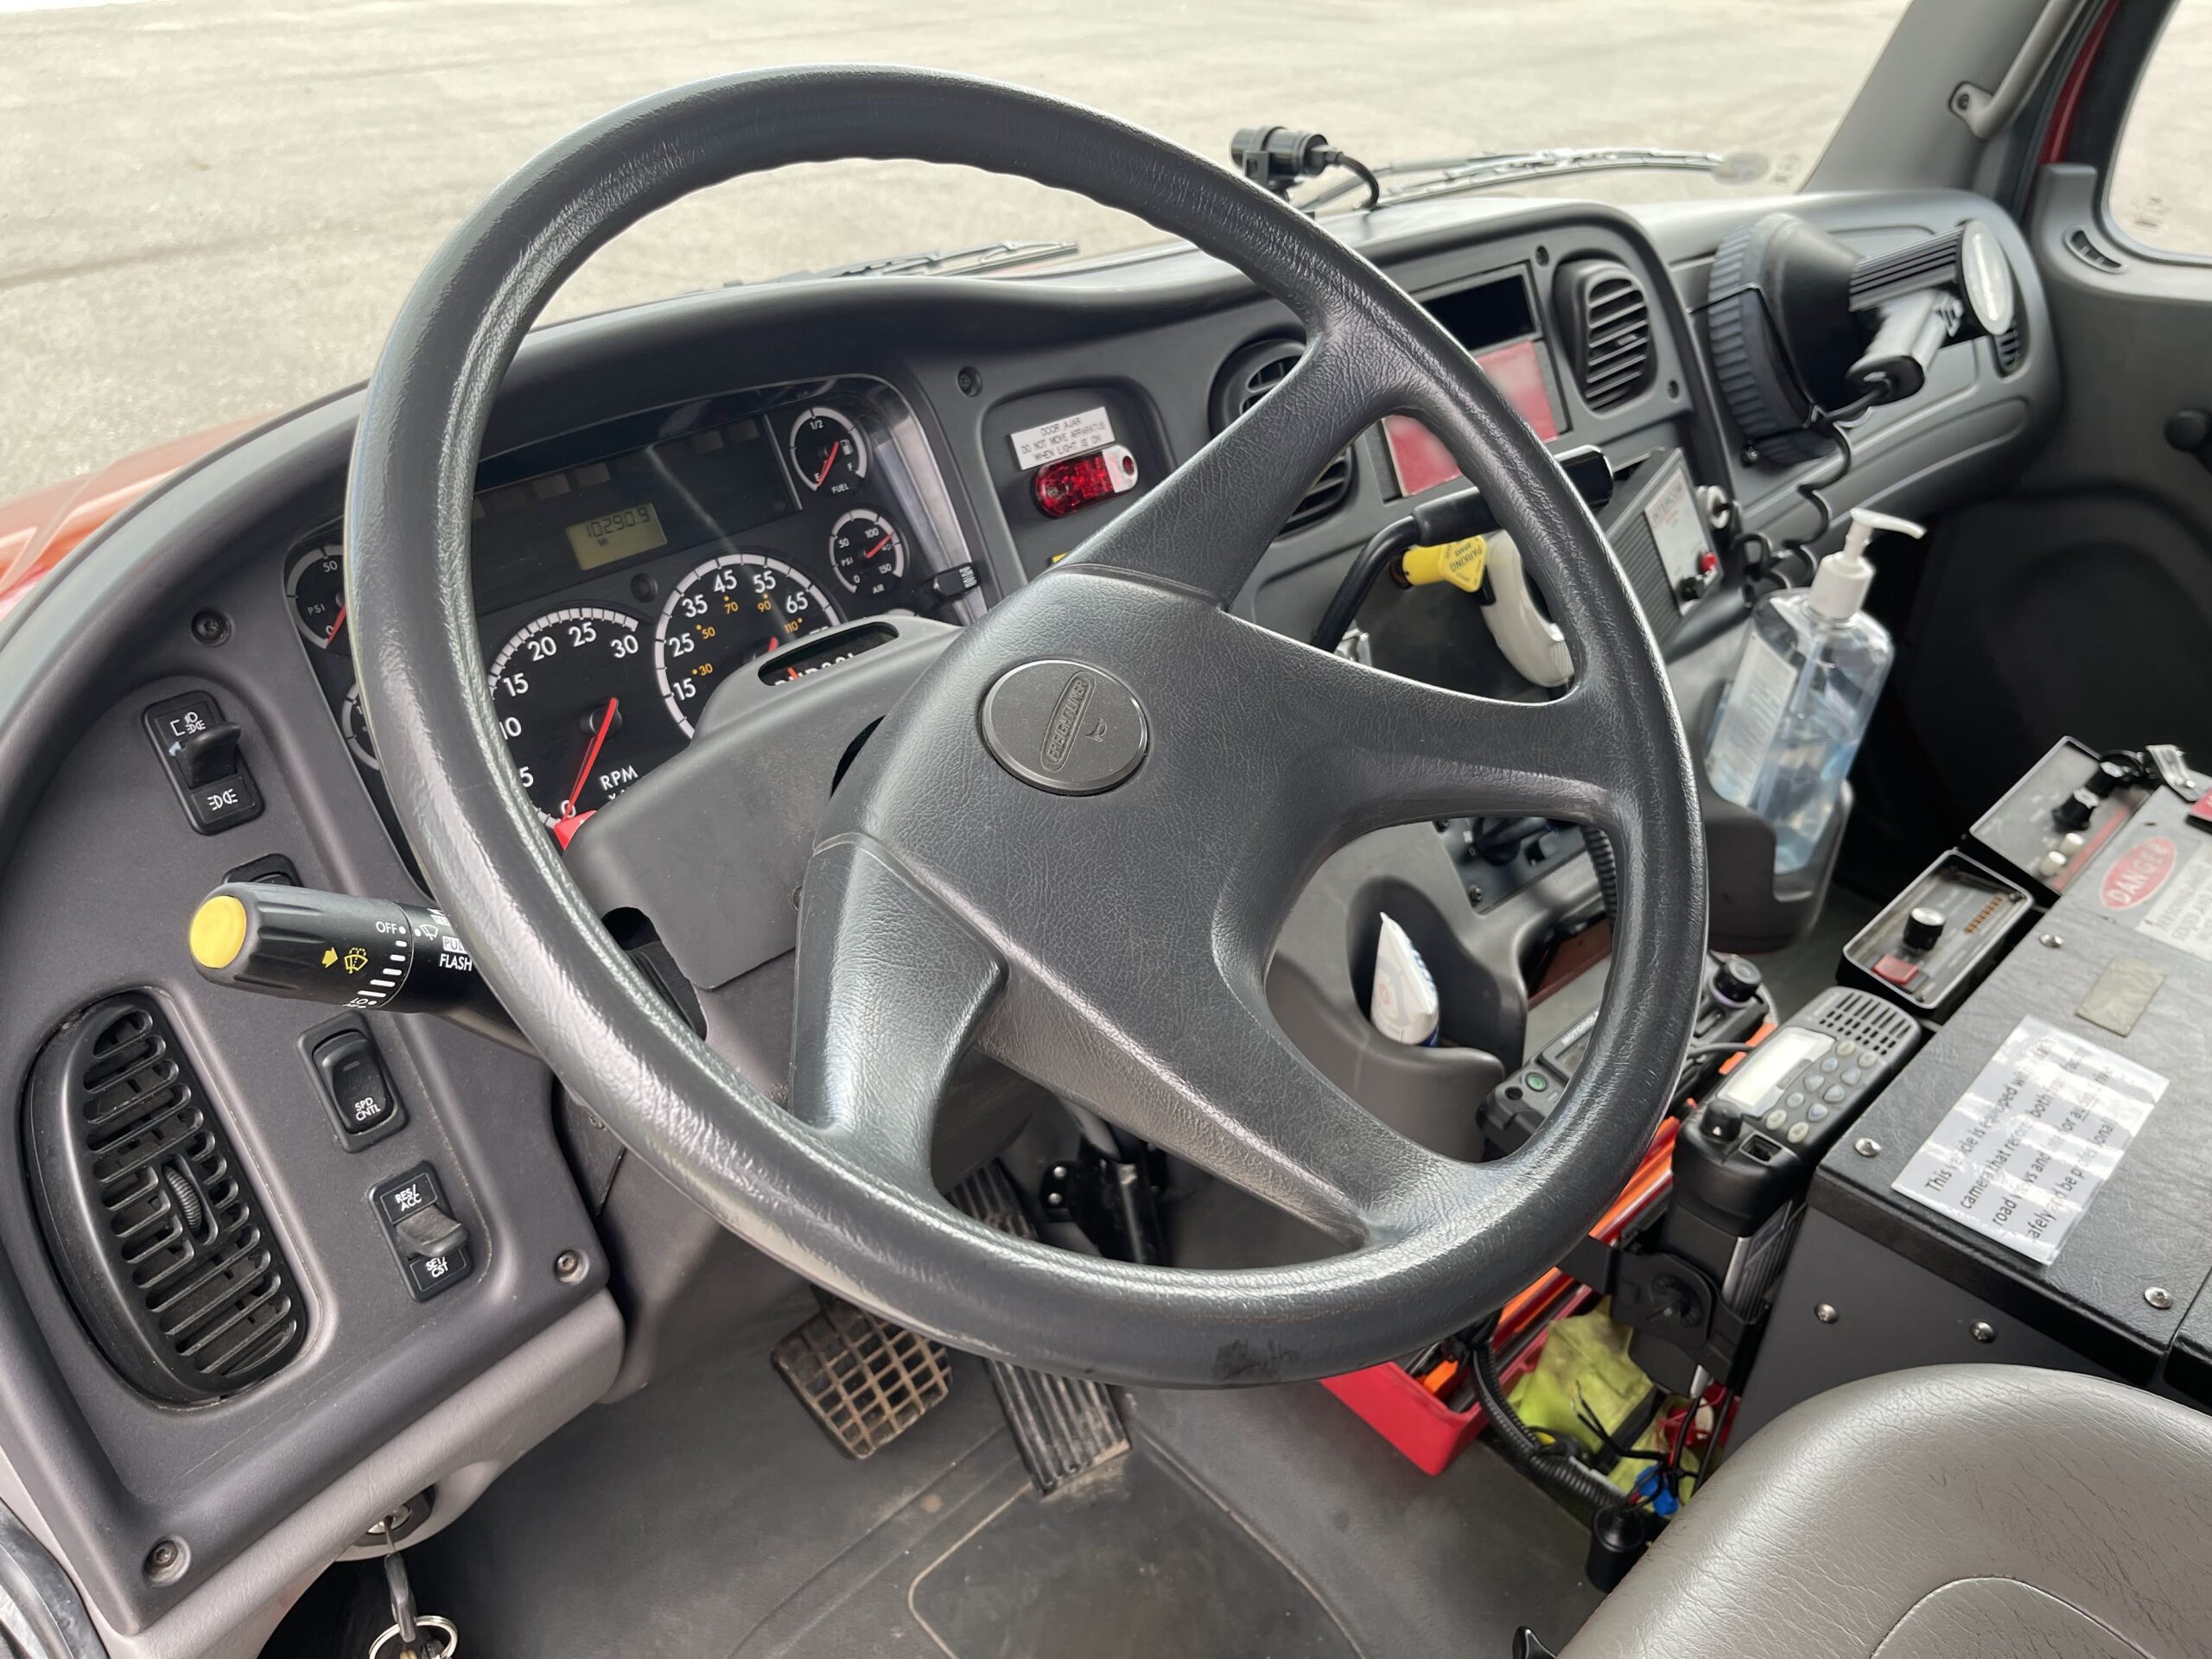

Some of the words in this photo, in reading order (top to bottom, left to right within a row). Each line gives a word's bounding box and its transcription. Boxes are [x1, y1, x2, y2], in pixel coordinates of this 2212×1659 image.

[1040, 423, 1060, 437] DOOR
[1033, 439, 1047, 450] NOT
[1050, 433, 1067, 445] MOVE
[832, 483, 849, 493] FUEL
[865, 528, 879, 538] 100
[838, 537, 850, 548] 50
[323, 561, 338, 572] 50
[841, 557, 853, 567] PSI
[1450, 546, 1482, 573] PARKING
[878, 563, 893, 575] 150
[714, 569, 737, 593] 45
[753, 570, 776, 594] 55
[873, 584, 885, 594] AIR
[308, 604, 325, 615] PSI
[682, 594, 708, 619] 35
[724, 601, 739, 614] 70
[757, 600, 772, 612] 90
[786, 591, 809, 613] 65
[569, 621, 597, 647] 25
[702, 626, 715, 639] 50
[785, 621, 798, 633] 110
[527, 636, 557, 661] 20
[610, 635, 639, 658] 30
[669, 632, 695, 658] 25
[699, 663, 713, 677] 30
[503, 673, 529, 696] 15
[673, 677, 696, 701] 15
[499, 717, 522, 741] 10
[1046, 678, 1088, 762] FREIGHTLINER
[519, 766, 534, 787] 5
[600, 765, 639, 791] RPM
[561, 800, 576, 818] 0
[2106, 842, 2171, 906] DANGER
[376, 921, 397, 934] OFF
[444, 938, 465, 951] PUL
[440, 953, 473, 971] FLASH
[355, 1097, 373, 1111] SPD
[356, 1103, 381, 1121] CNTL
[1924, 1167, 1953, 1192] This
[1944, 1135, 1979, 1170] veicle
[1967, 1126, 1986, 1138] is
[1959, 1170, 1994, 1211] camera
[1985, 1148, 2012, 1173] that
[2023, 1091, 2053, 1119] both
[1992, 1197, 2018, 1226] road
[2031, 1151, 2051, 1173] and
[2056, 1175, 2077, 1192] be
[395, 1184, 416, 1204] RES/
[402, 1193, 422, 1211] ACC
[432, 1262, 448, 1277] CST
